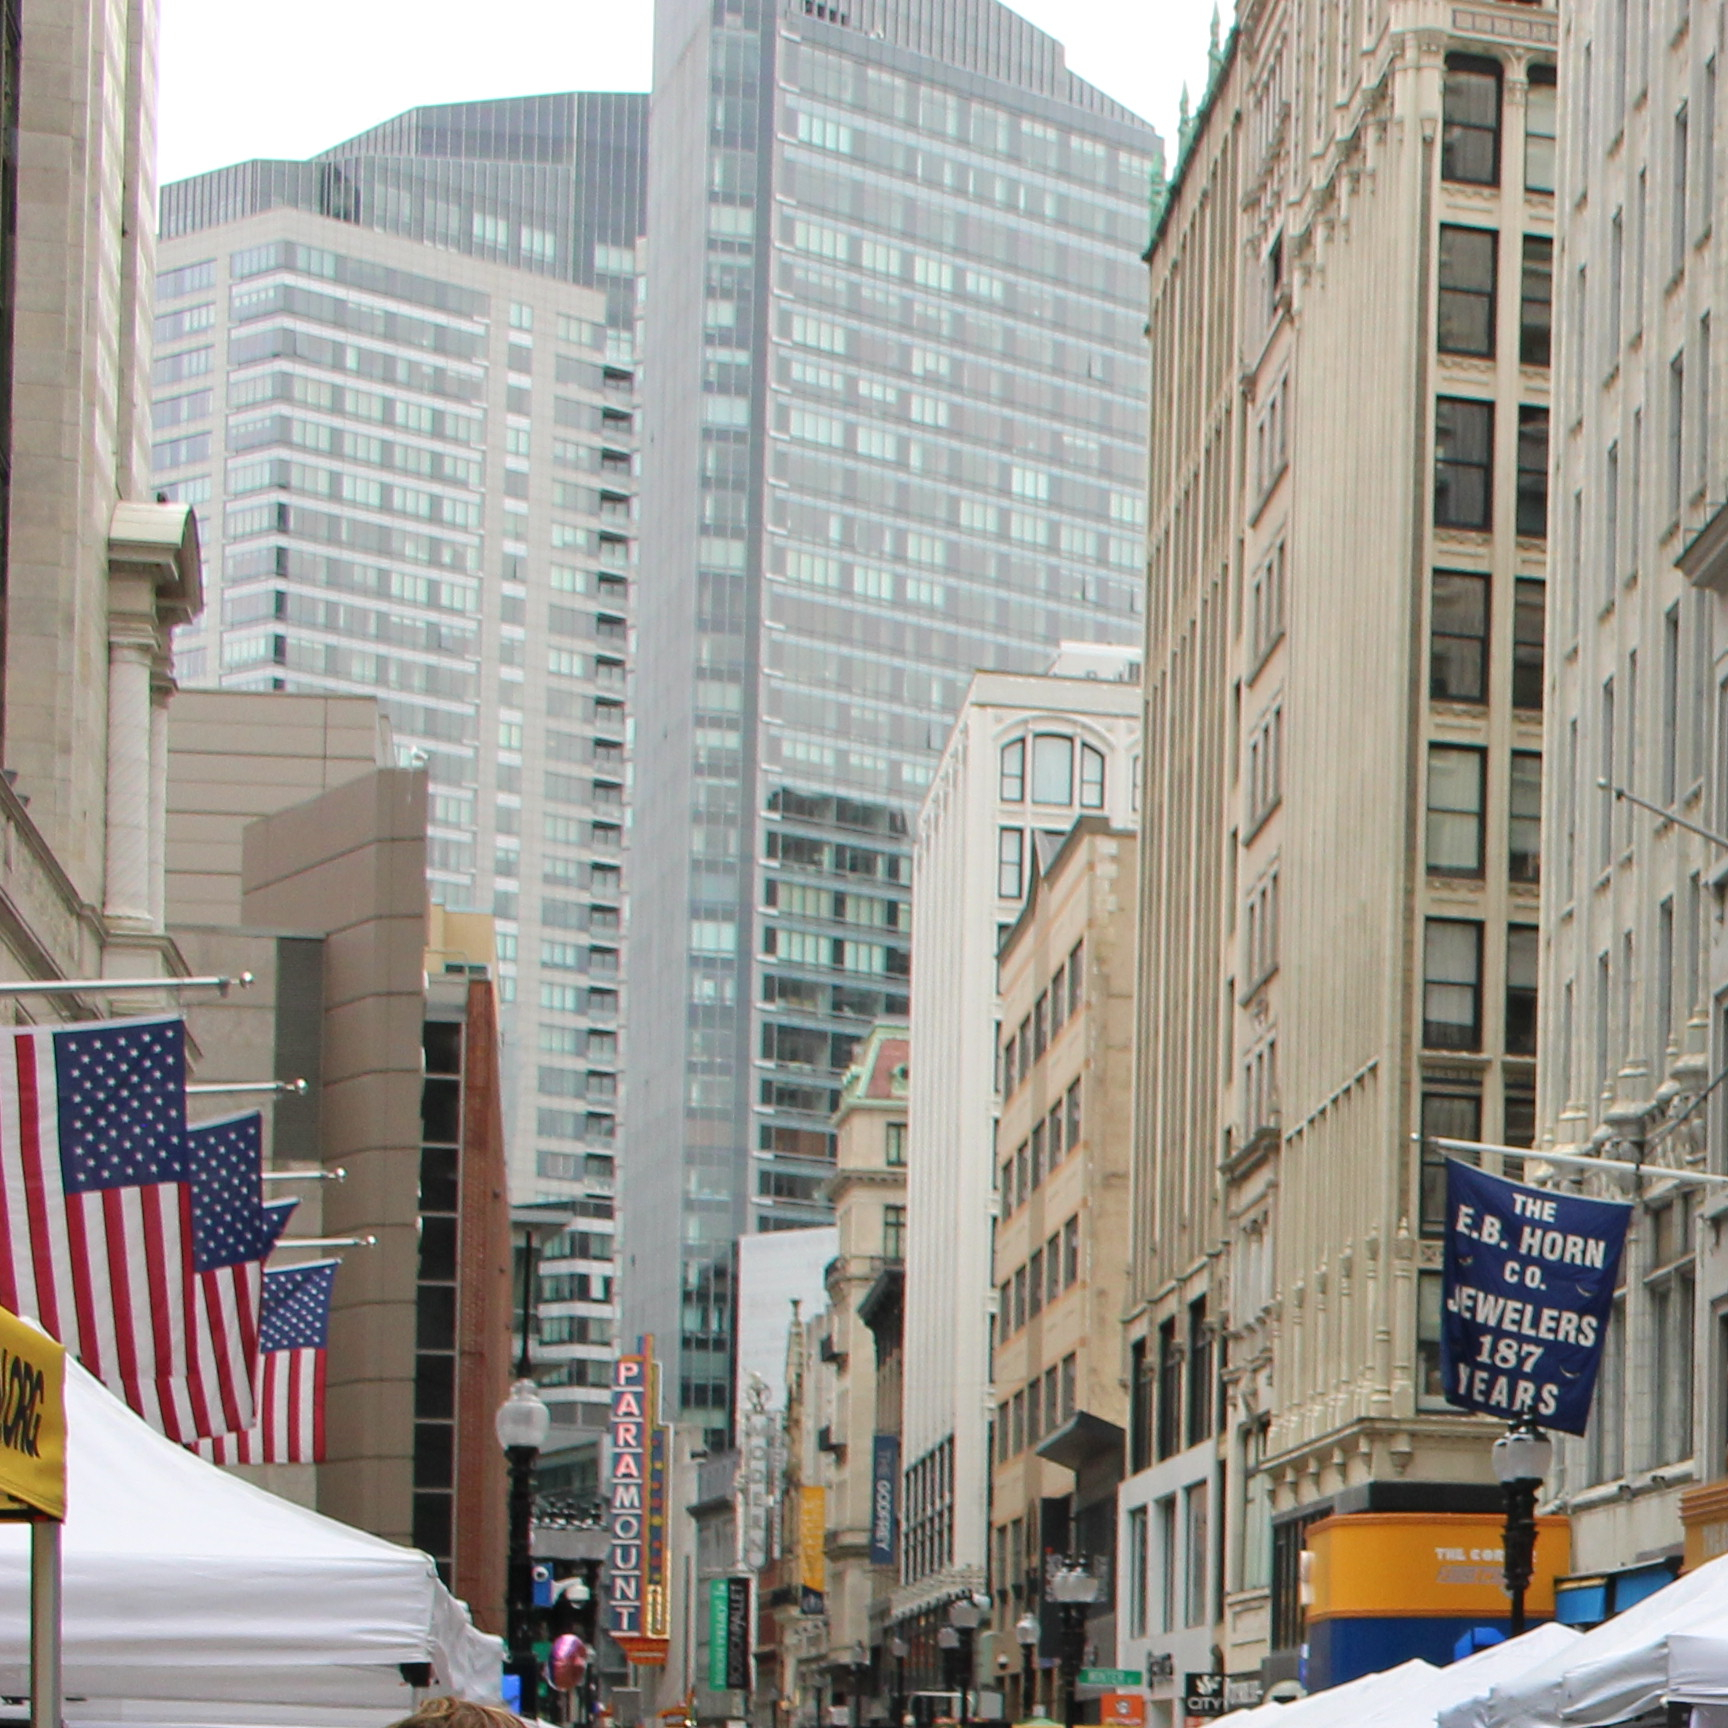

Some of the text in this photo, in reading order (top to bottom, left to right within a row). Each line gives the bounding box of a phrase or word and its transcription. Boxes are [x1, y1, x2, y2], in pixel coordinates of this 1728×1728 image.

[1512, 1193, 1557, 1223] THE
[1455, 1204, 1607, 1270] E.B. HORN
[1447, 1284, 1598, 1348] JEWELERS
[1475, 1333, 1545, 1373] 187
[1457, 1362, 1560, 1416] YEARS
[613, 1361, 641, 1631] PARAMOUNT
[1435, 1547, 1465, 1561] THE
